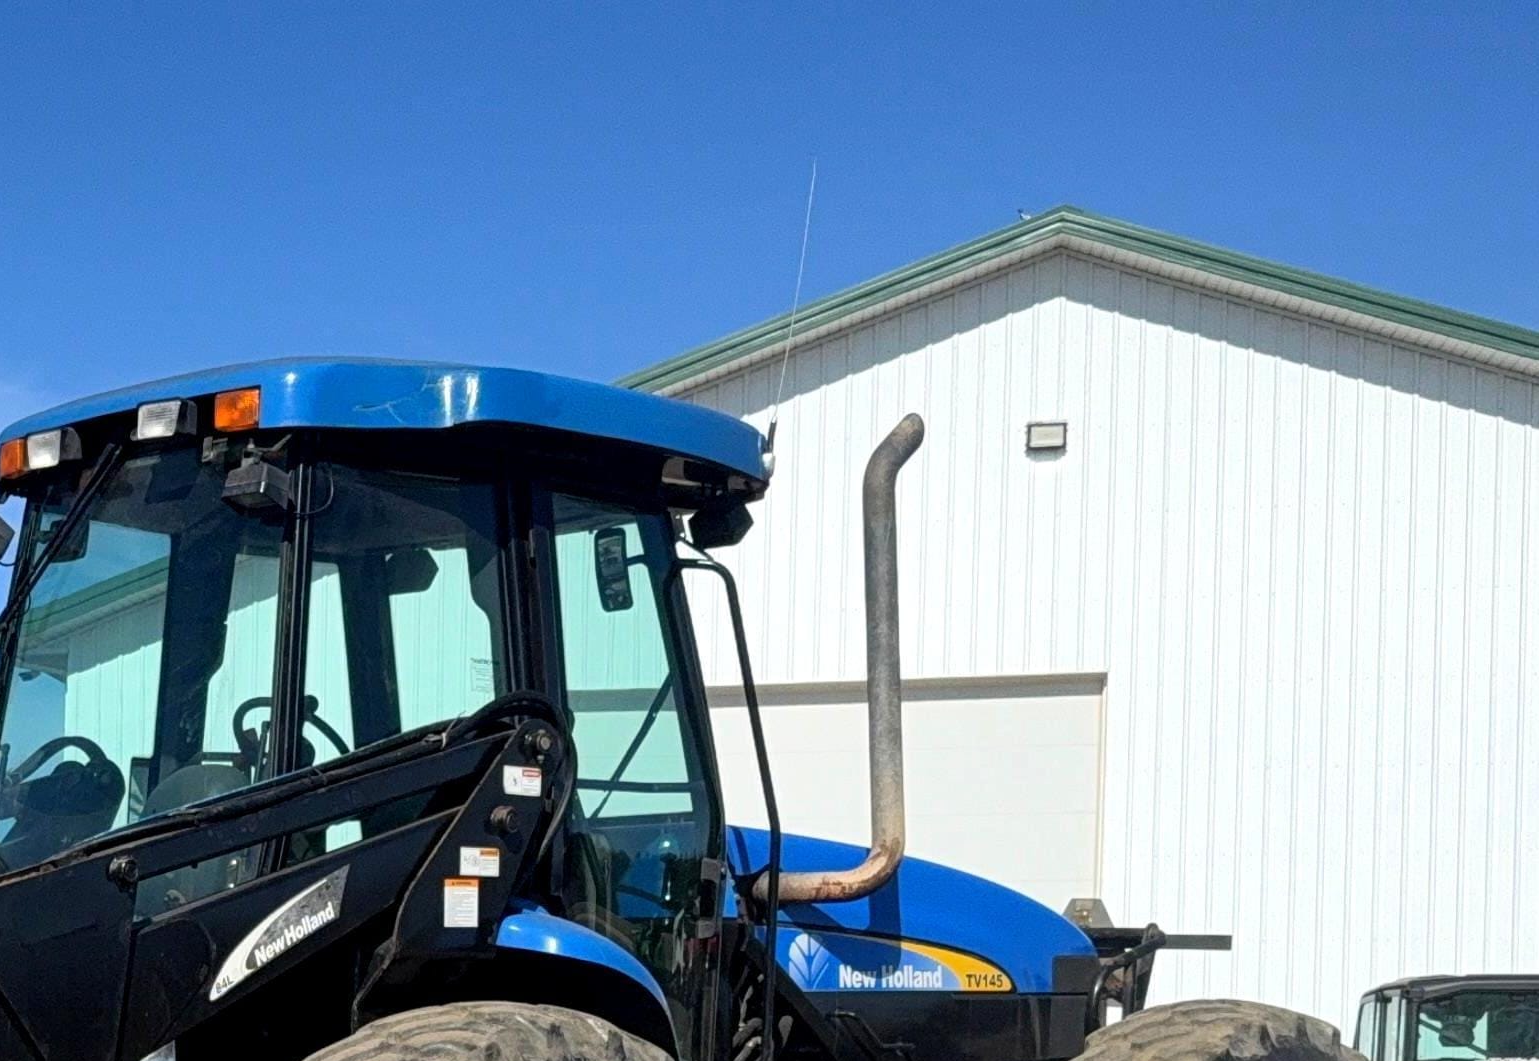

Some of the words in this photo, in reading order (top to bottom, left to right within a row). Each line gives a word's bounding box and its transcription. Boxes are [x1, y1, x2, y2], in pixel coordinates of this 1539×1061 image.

[254, 938, 286, 967] New
[284, 901, 335, 946] Holland
[839, 964, 876, 988] New
[881, 965, 942, 988] Holland
[966, 974, 1003, 988] TV145
